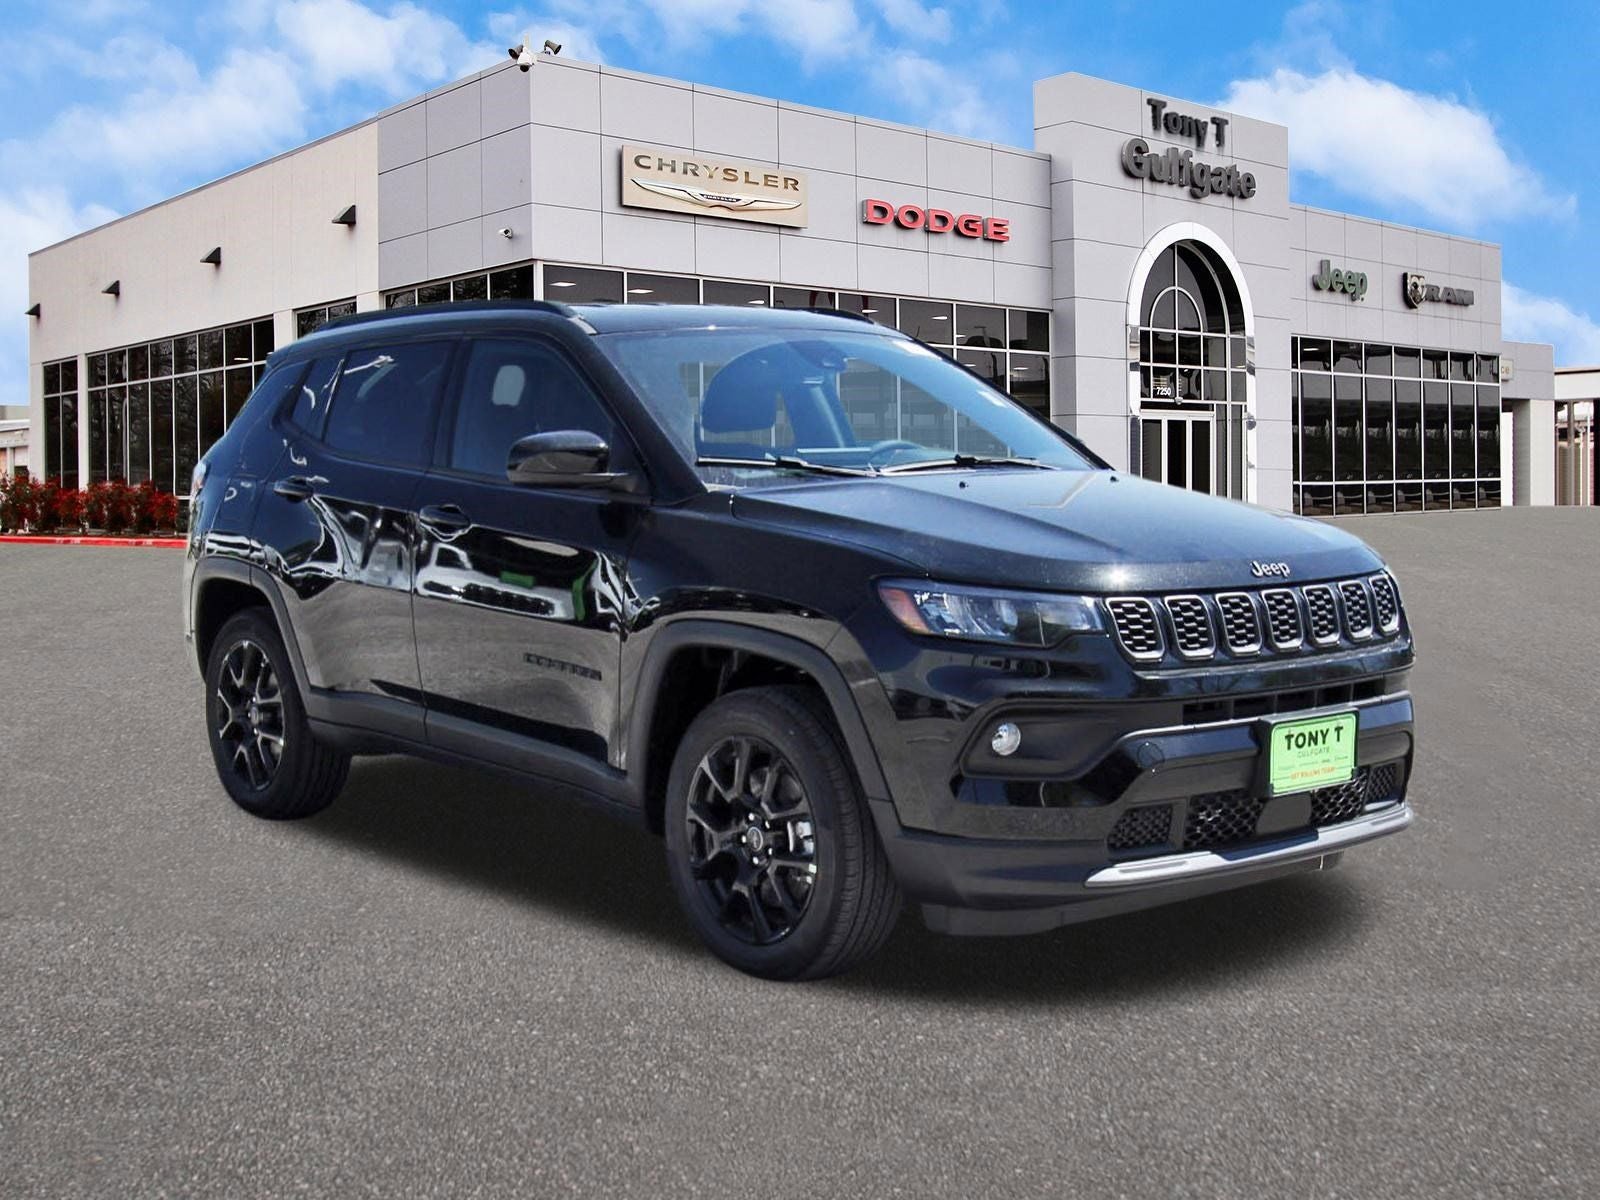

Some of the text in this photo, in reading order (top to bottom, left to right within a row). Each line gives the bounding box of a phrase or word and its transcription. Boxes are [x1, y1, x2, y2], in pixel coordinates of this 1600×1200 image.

[1147, 98, 1229, 147] Tony T
[633, 153, 800, 192] CHRYSLER
[1122, 138, 1256, 199] Gulfgate
[863, 199, 1010, 242] DODGE
[1313, 259, 1368, 302] Jeep
[1425, 284, 1475, 306] RAM
[1156, 386, 1172, 396] 7250
[1250, 561, 1291, 578] Jeep
[1284, 725, 1344, 751] TONY T
